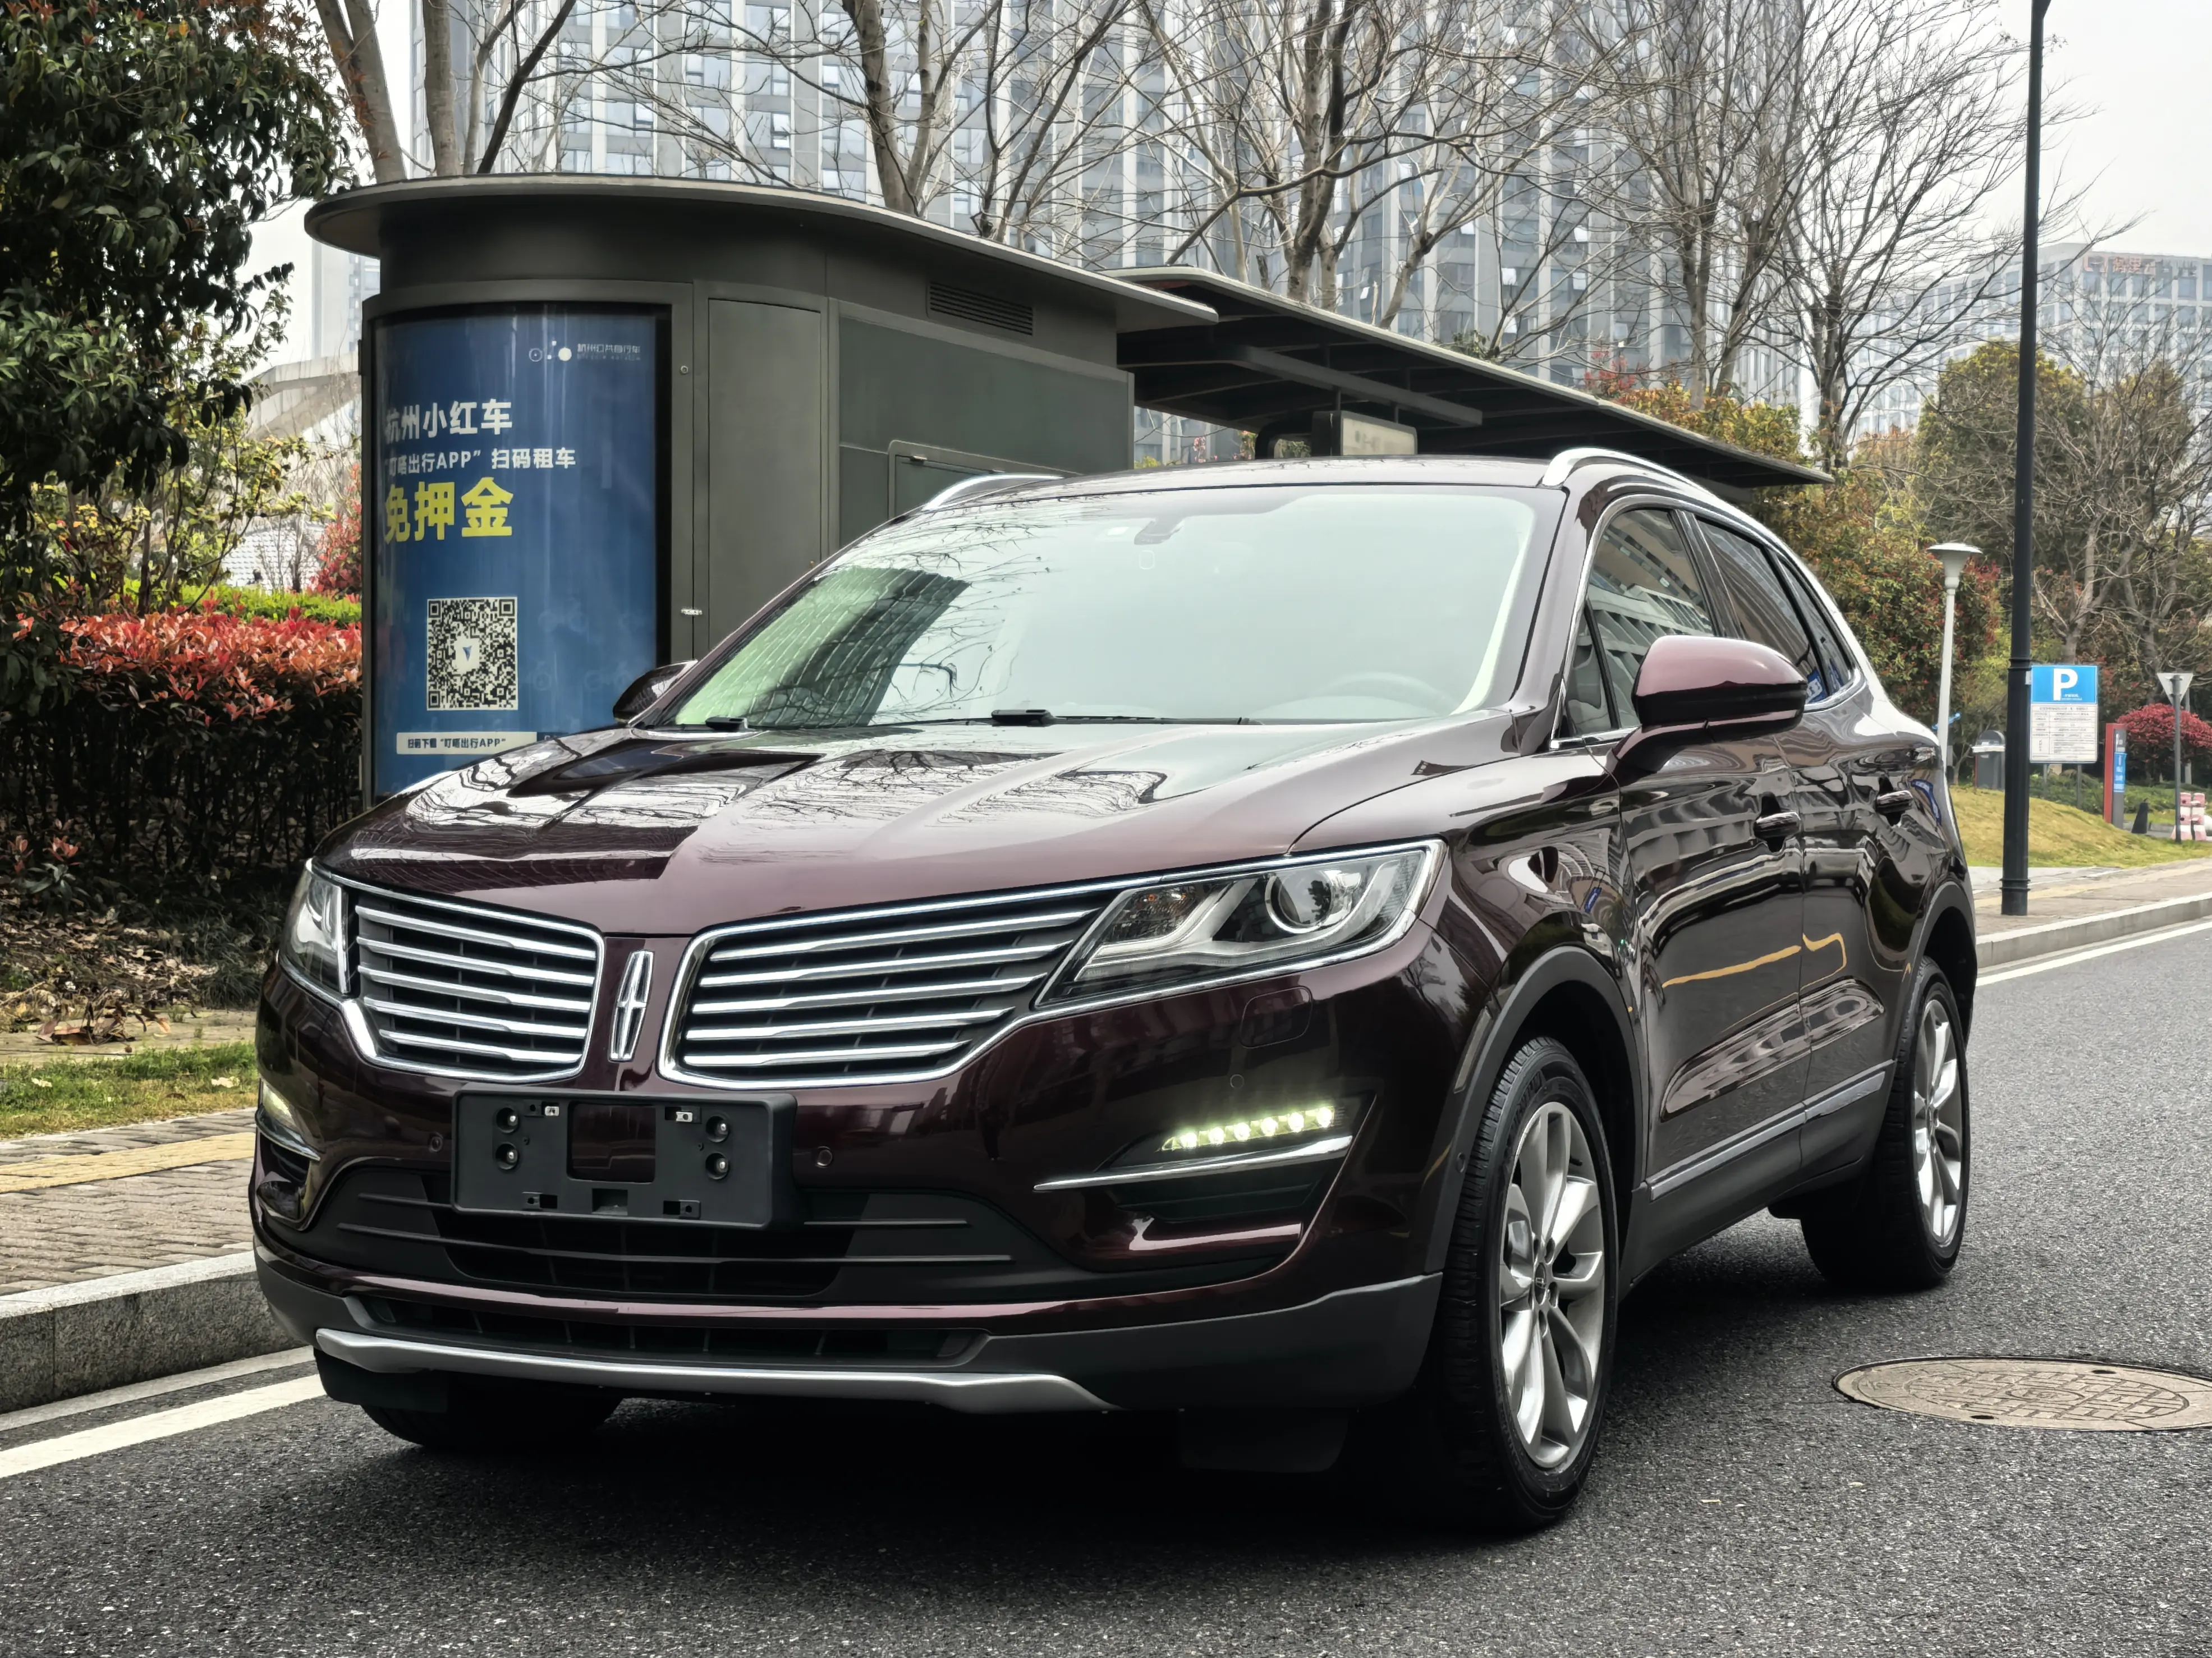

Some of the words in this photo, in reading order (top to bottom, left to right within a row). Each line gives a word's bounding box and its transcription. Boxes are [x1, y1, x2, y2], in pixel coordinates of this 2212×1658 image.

[385, 398, 513, 443] 杭州小红车
[492, 447, 576, 469] 扫码租车
[384, 477, 513, 543] 免押金
[2053, 668, 2078, 700] P
